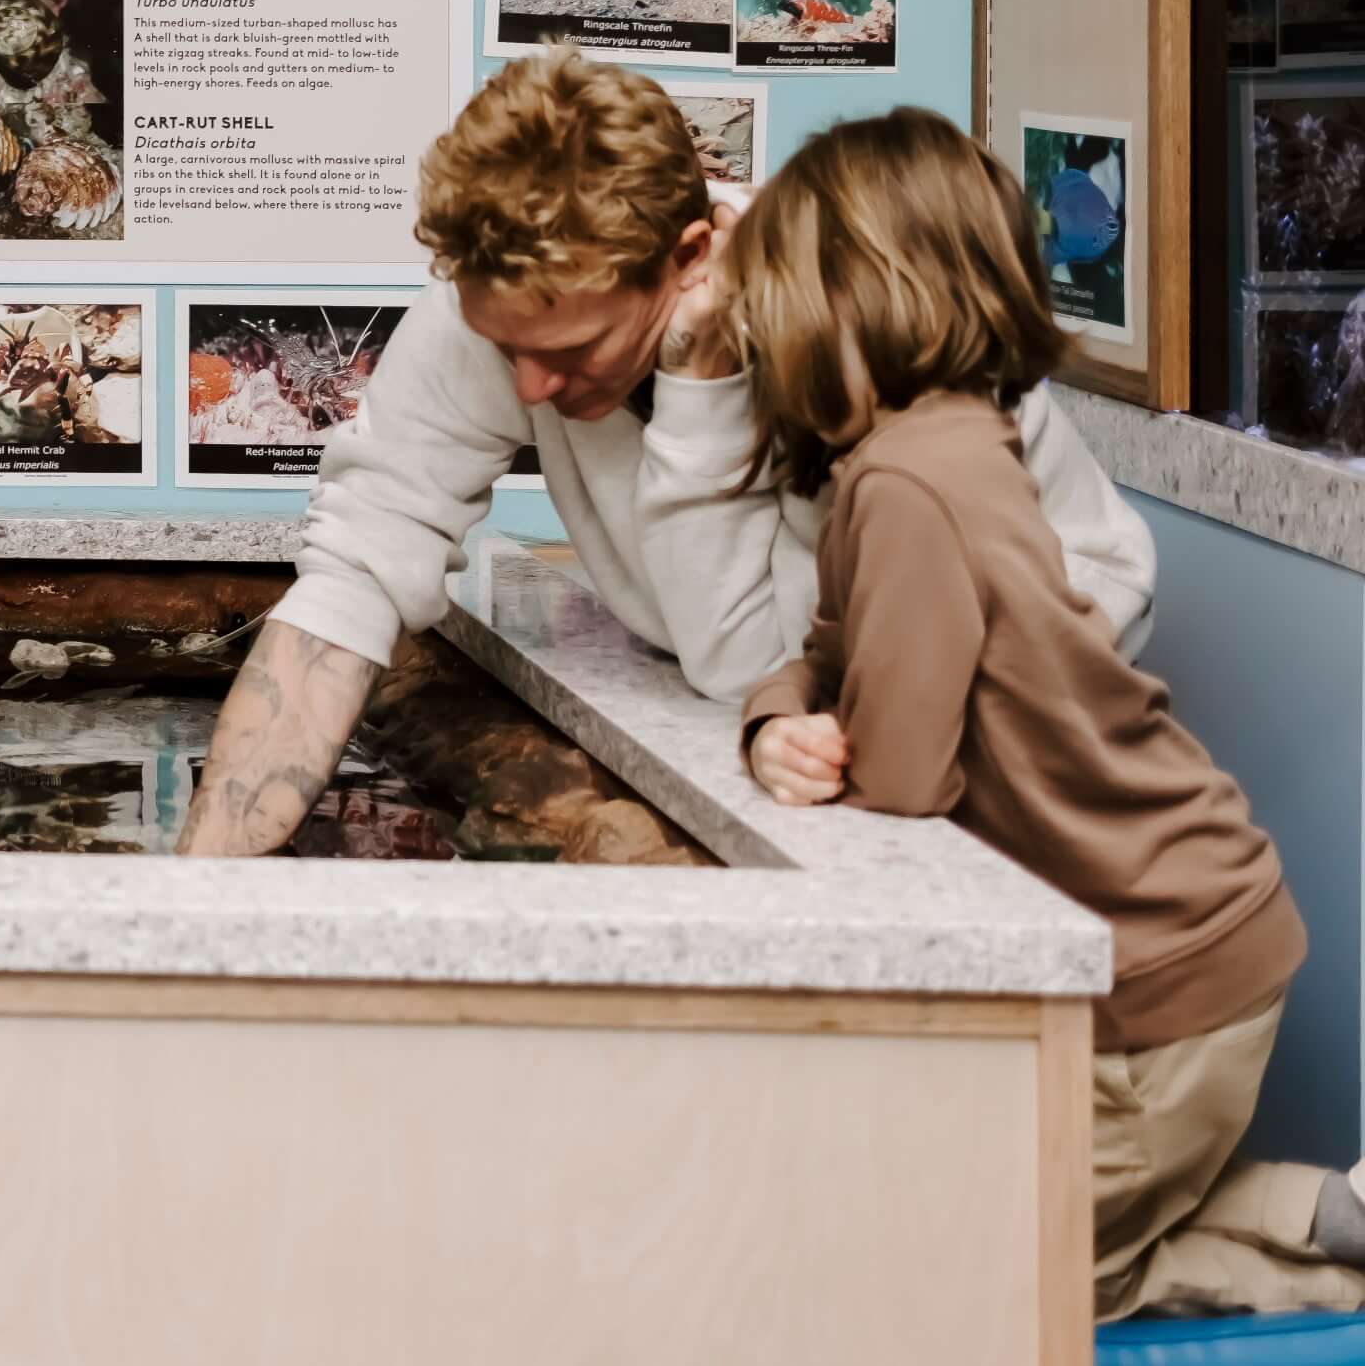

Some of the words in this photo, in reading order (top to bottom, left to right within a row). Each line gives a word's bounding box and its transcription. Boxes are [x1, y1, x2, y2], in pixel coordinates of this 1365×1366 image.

[582, 20, 629, 31] Ringscale
[632, 22, 673, 33] Threefin
[778, 44, 816, 54] Ringscale
[816, 44, 854, 53] Three-Fin
[134, 116, 217, 129] CART-RUT
[221, 116, 274, 130] SHELL
[134, 135, 206, 149] Dicathais
[210, 136, 256, 149] orbita
[7, 445, 40, 455] Hermit
[42, 445, 66, 455] Crab
[245, 447, 305, 457] Red-Handed
[13, 460, 60, 471] imperialis
